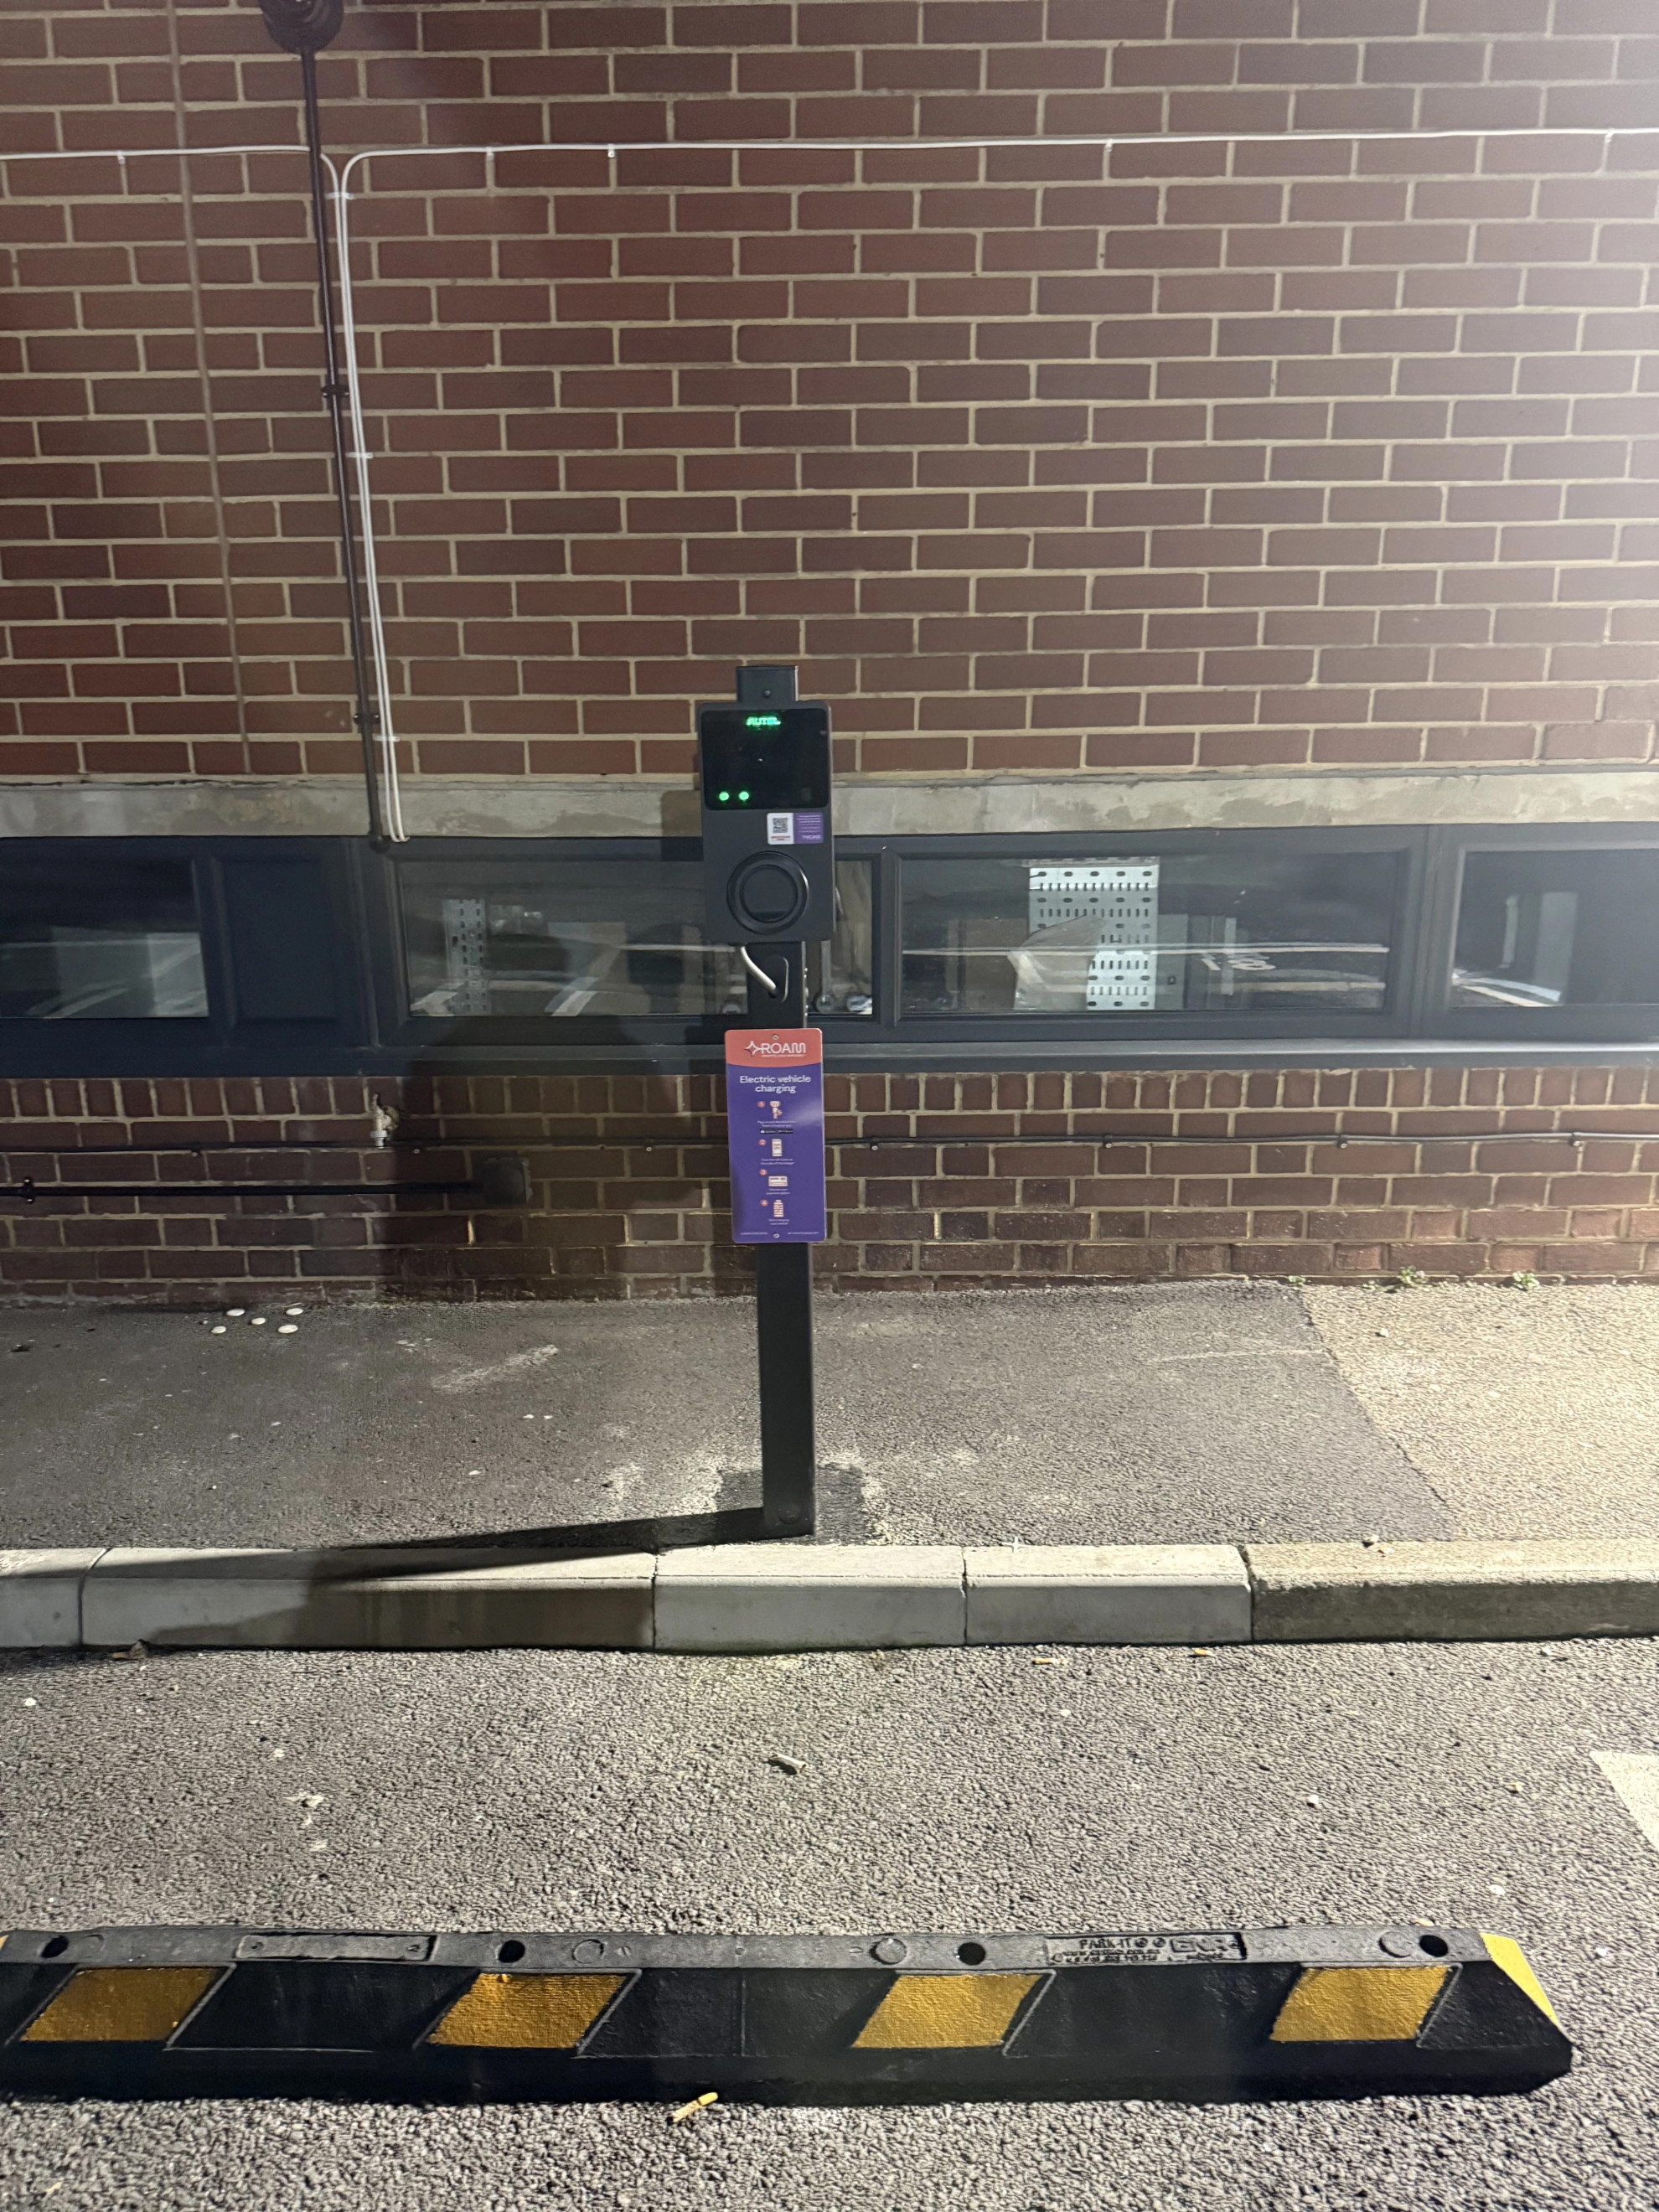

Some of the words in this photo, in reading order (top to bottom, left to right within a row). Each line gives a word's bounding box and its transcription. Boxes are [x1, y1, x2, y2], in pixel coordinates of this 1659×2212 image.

[761, 1042, 806, 1054] ROAM
[739, 1075, 776, 1083] Electric
[777, 1074, 811, 1083] vehicle
[755, 1084, 797, 1094] charging
